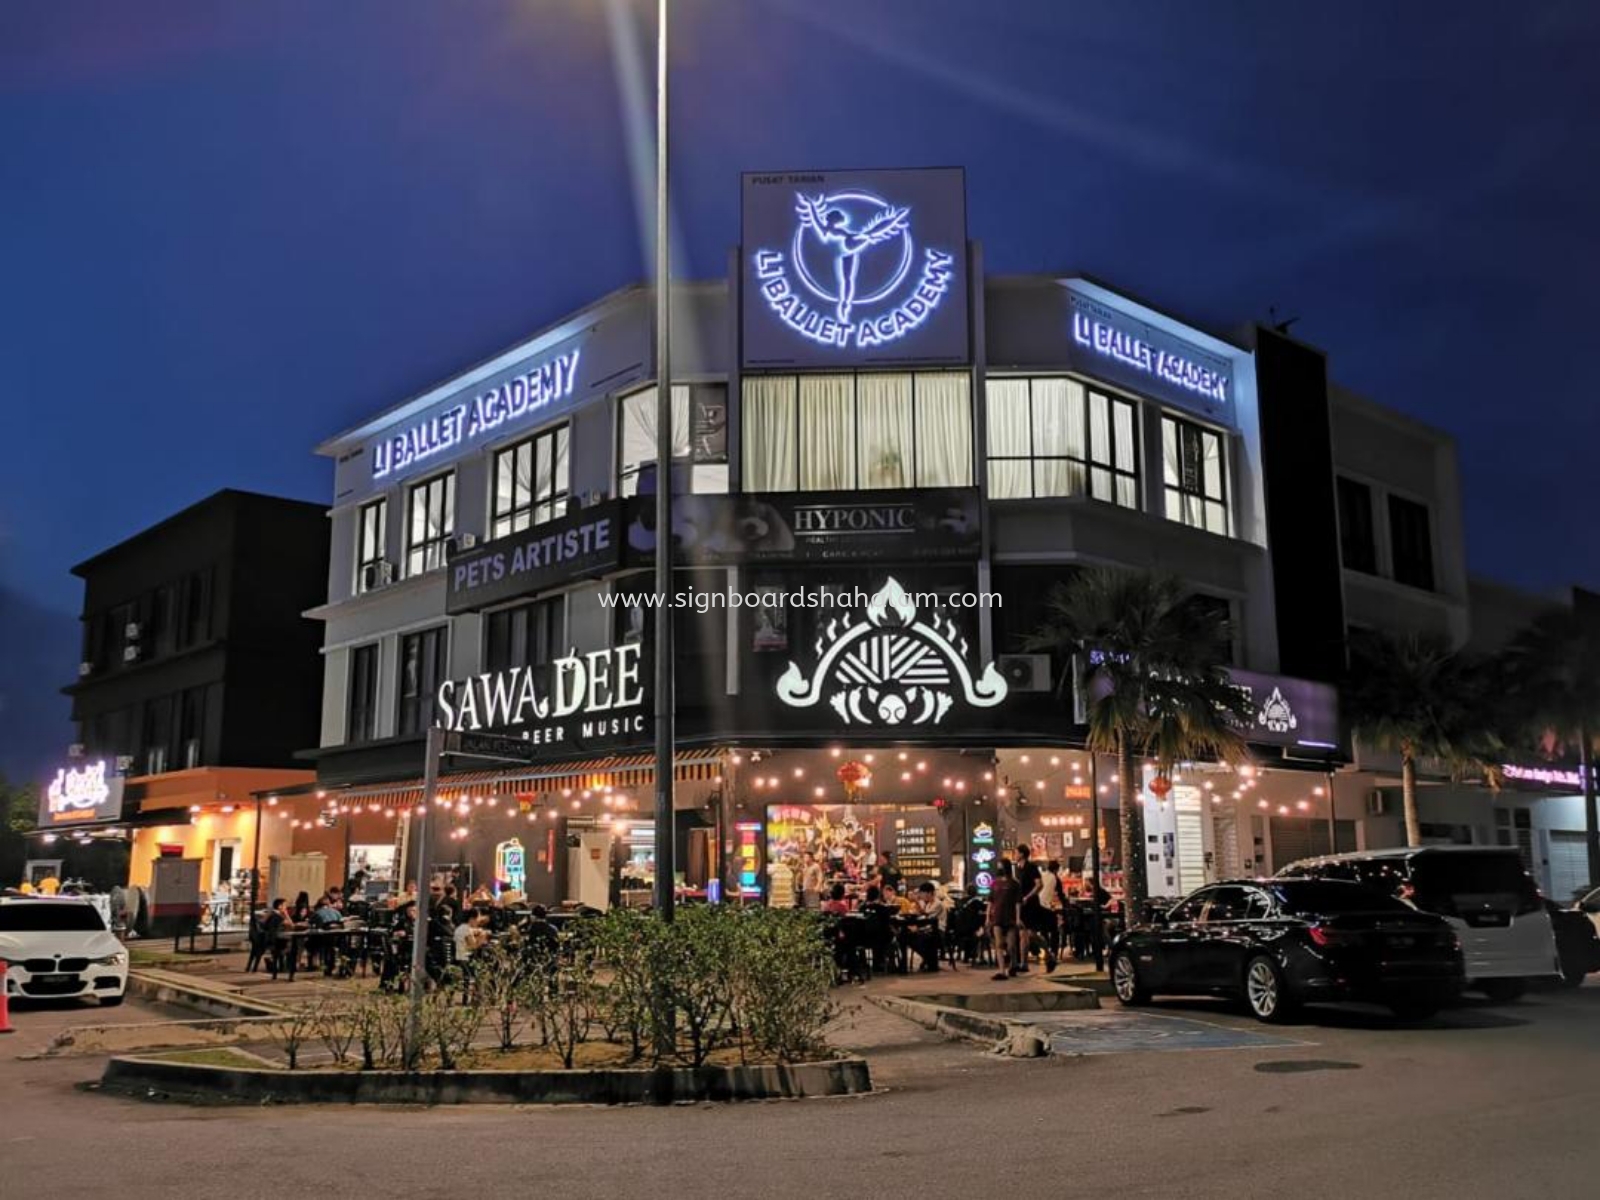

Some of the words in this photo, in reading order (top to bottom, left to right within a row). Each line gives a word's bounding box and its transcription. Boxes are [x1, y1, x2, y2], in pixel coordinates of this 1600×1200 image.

[757, 249, 784, 278] LI
[857, 248, 953, 347] ACADEMY
[762, 276, 854, 346] BALLET
[1074, 312, 1091, 346] LI
[1093, 322, 1157, 372] BALLET
[1157, 350, 1229, 403] ACADEMY
[372, 439, 392, 479] LI
[393, 404, 467, 471] BALLET
[468, 348, 580, 437] ACADEMY
[453, 553, 505, 592] PETS
[510, 518, 611, 575] ARTISTE
[794, 508, 916, 530] HYPONIC
[581, 714, 645, 739] MUSIC
